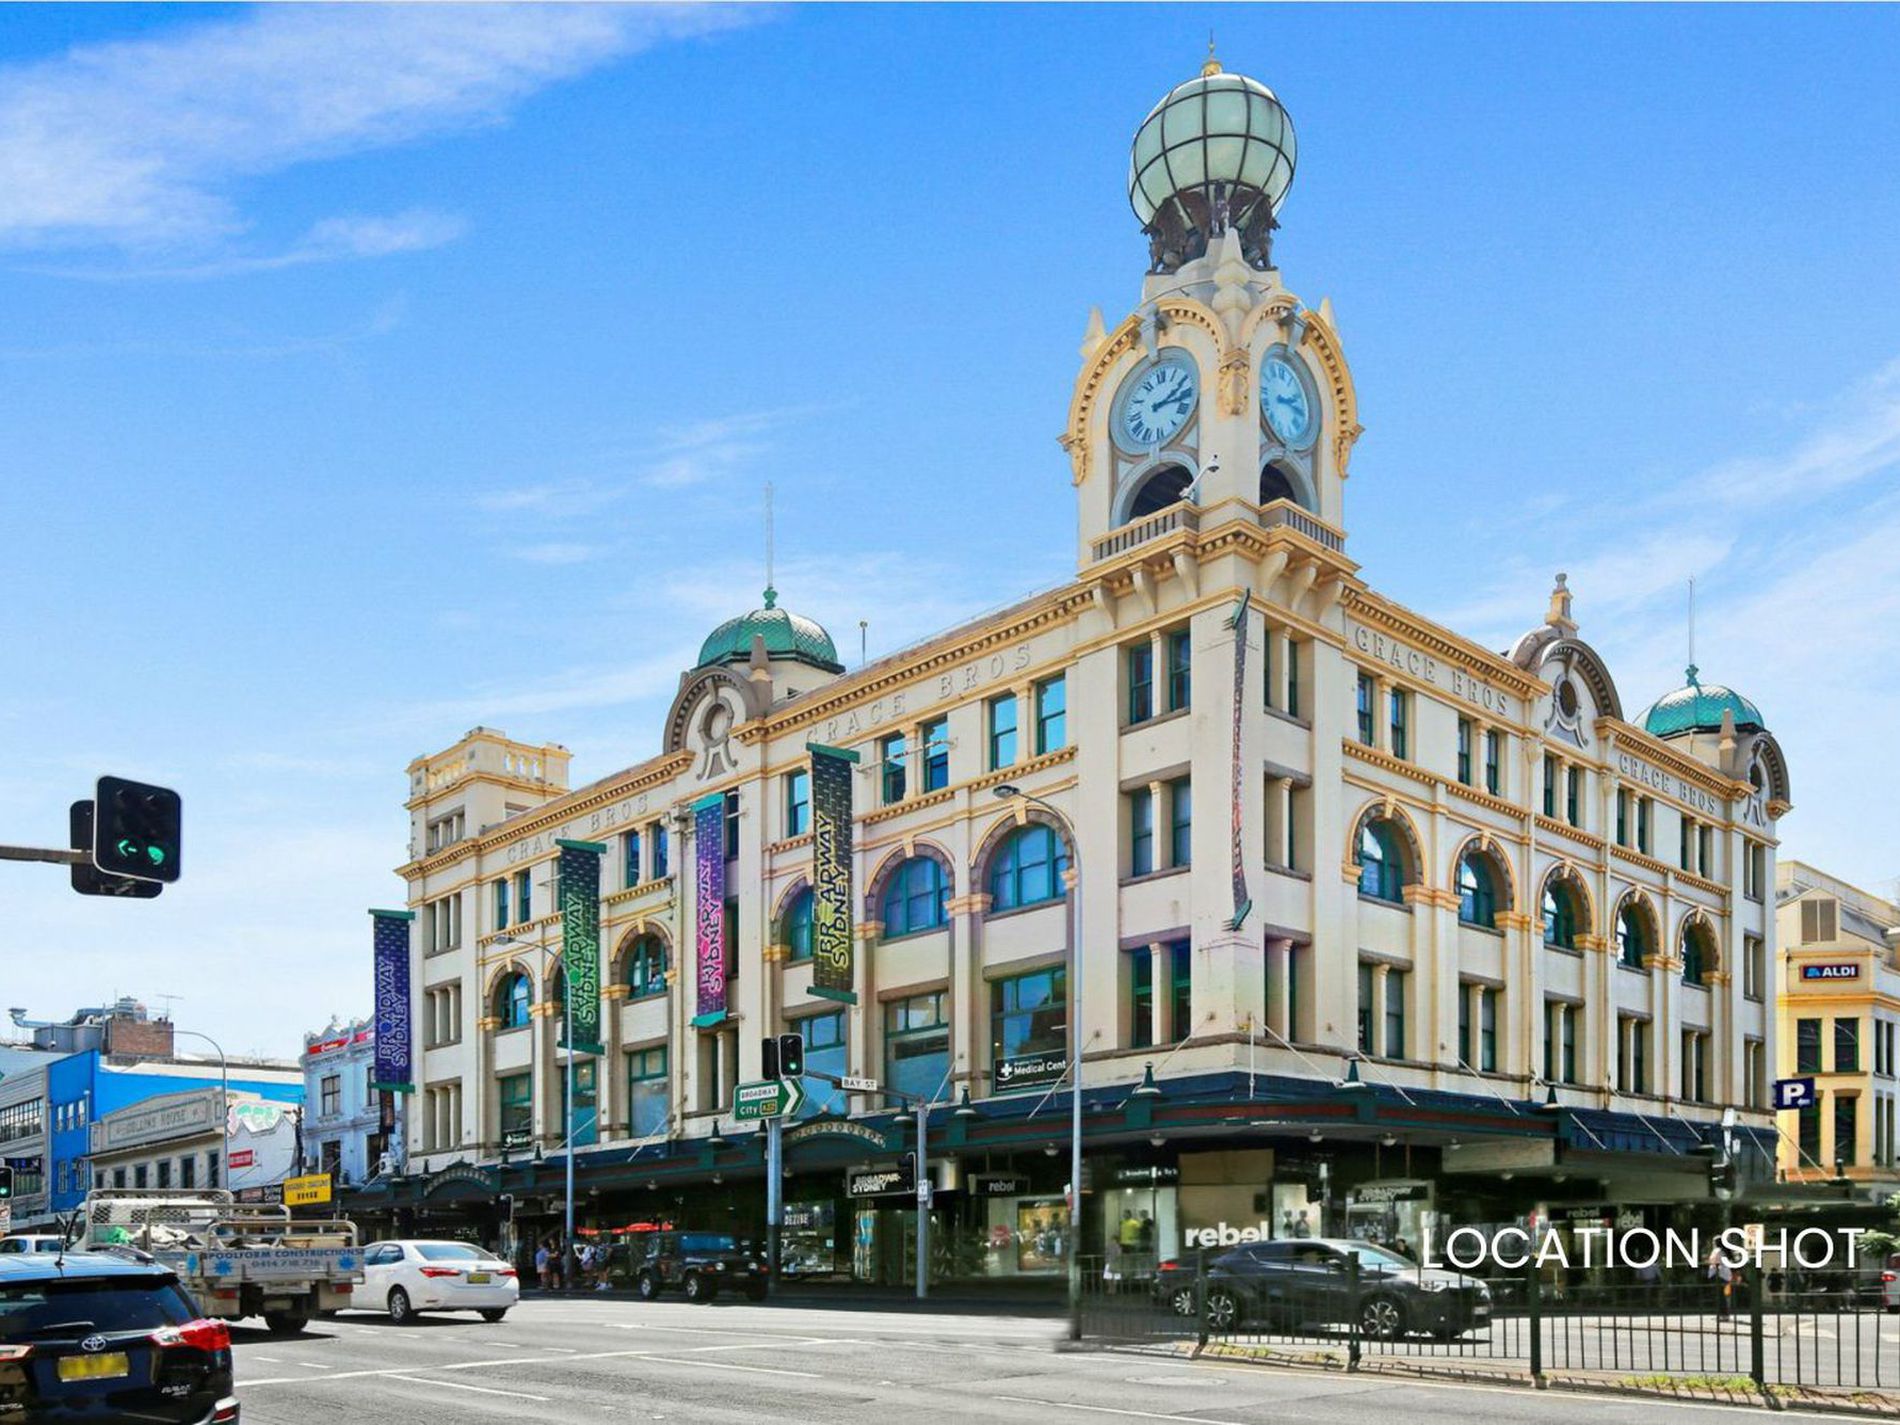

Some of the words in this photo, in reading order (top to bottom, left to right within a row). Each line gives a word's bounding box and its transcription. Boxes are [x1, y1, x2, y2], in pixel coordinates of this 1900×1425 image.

[1355, 625, 1436, 684] GRACE
[1452, 669, 1507, 717] BROS
[805, 693, 907, 745] GRACE
[937, 644, 1032, 699] BROS
[1619, 753, 1671, 794] GRACE
[1679, 782, 1716, 815] BROS
[590, 794, 648, 833] BROS
[831, 865, 848, 968] SYDNEY
[709, 900, 722, 993] SYDNEY
[579, 937, 597, 1024] SYDNEY
[1822, 967, 1856, 977] ALDI
[378, 956, 394, 1060] BROADWAY
[391, 993, 408, 1068] SYDNEY
[1014, 1062, 1045, 1075] Medical
[741, 1086, 777, 1099] BROADWAY
[843, 1079, 860, 1088] BAY
[865, 1080, 875, 1089] ST
[739, 1105, 758, 1116] City
[852, 1181, 887, 1193] SYDNEY
[988, 1180, 1015, 1192] rebel
[1566, 1207, 1600, 1218] rebel
[1185, 1221, 1268, 1247] rebel
[275, 1249, 361, 1258] CONSTRUCTIONS
